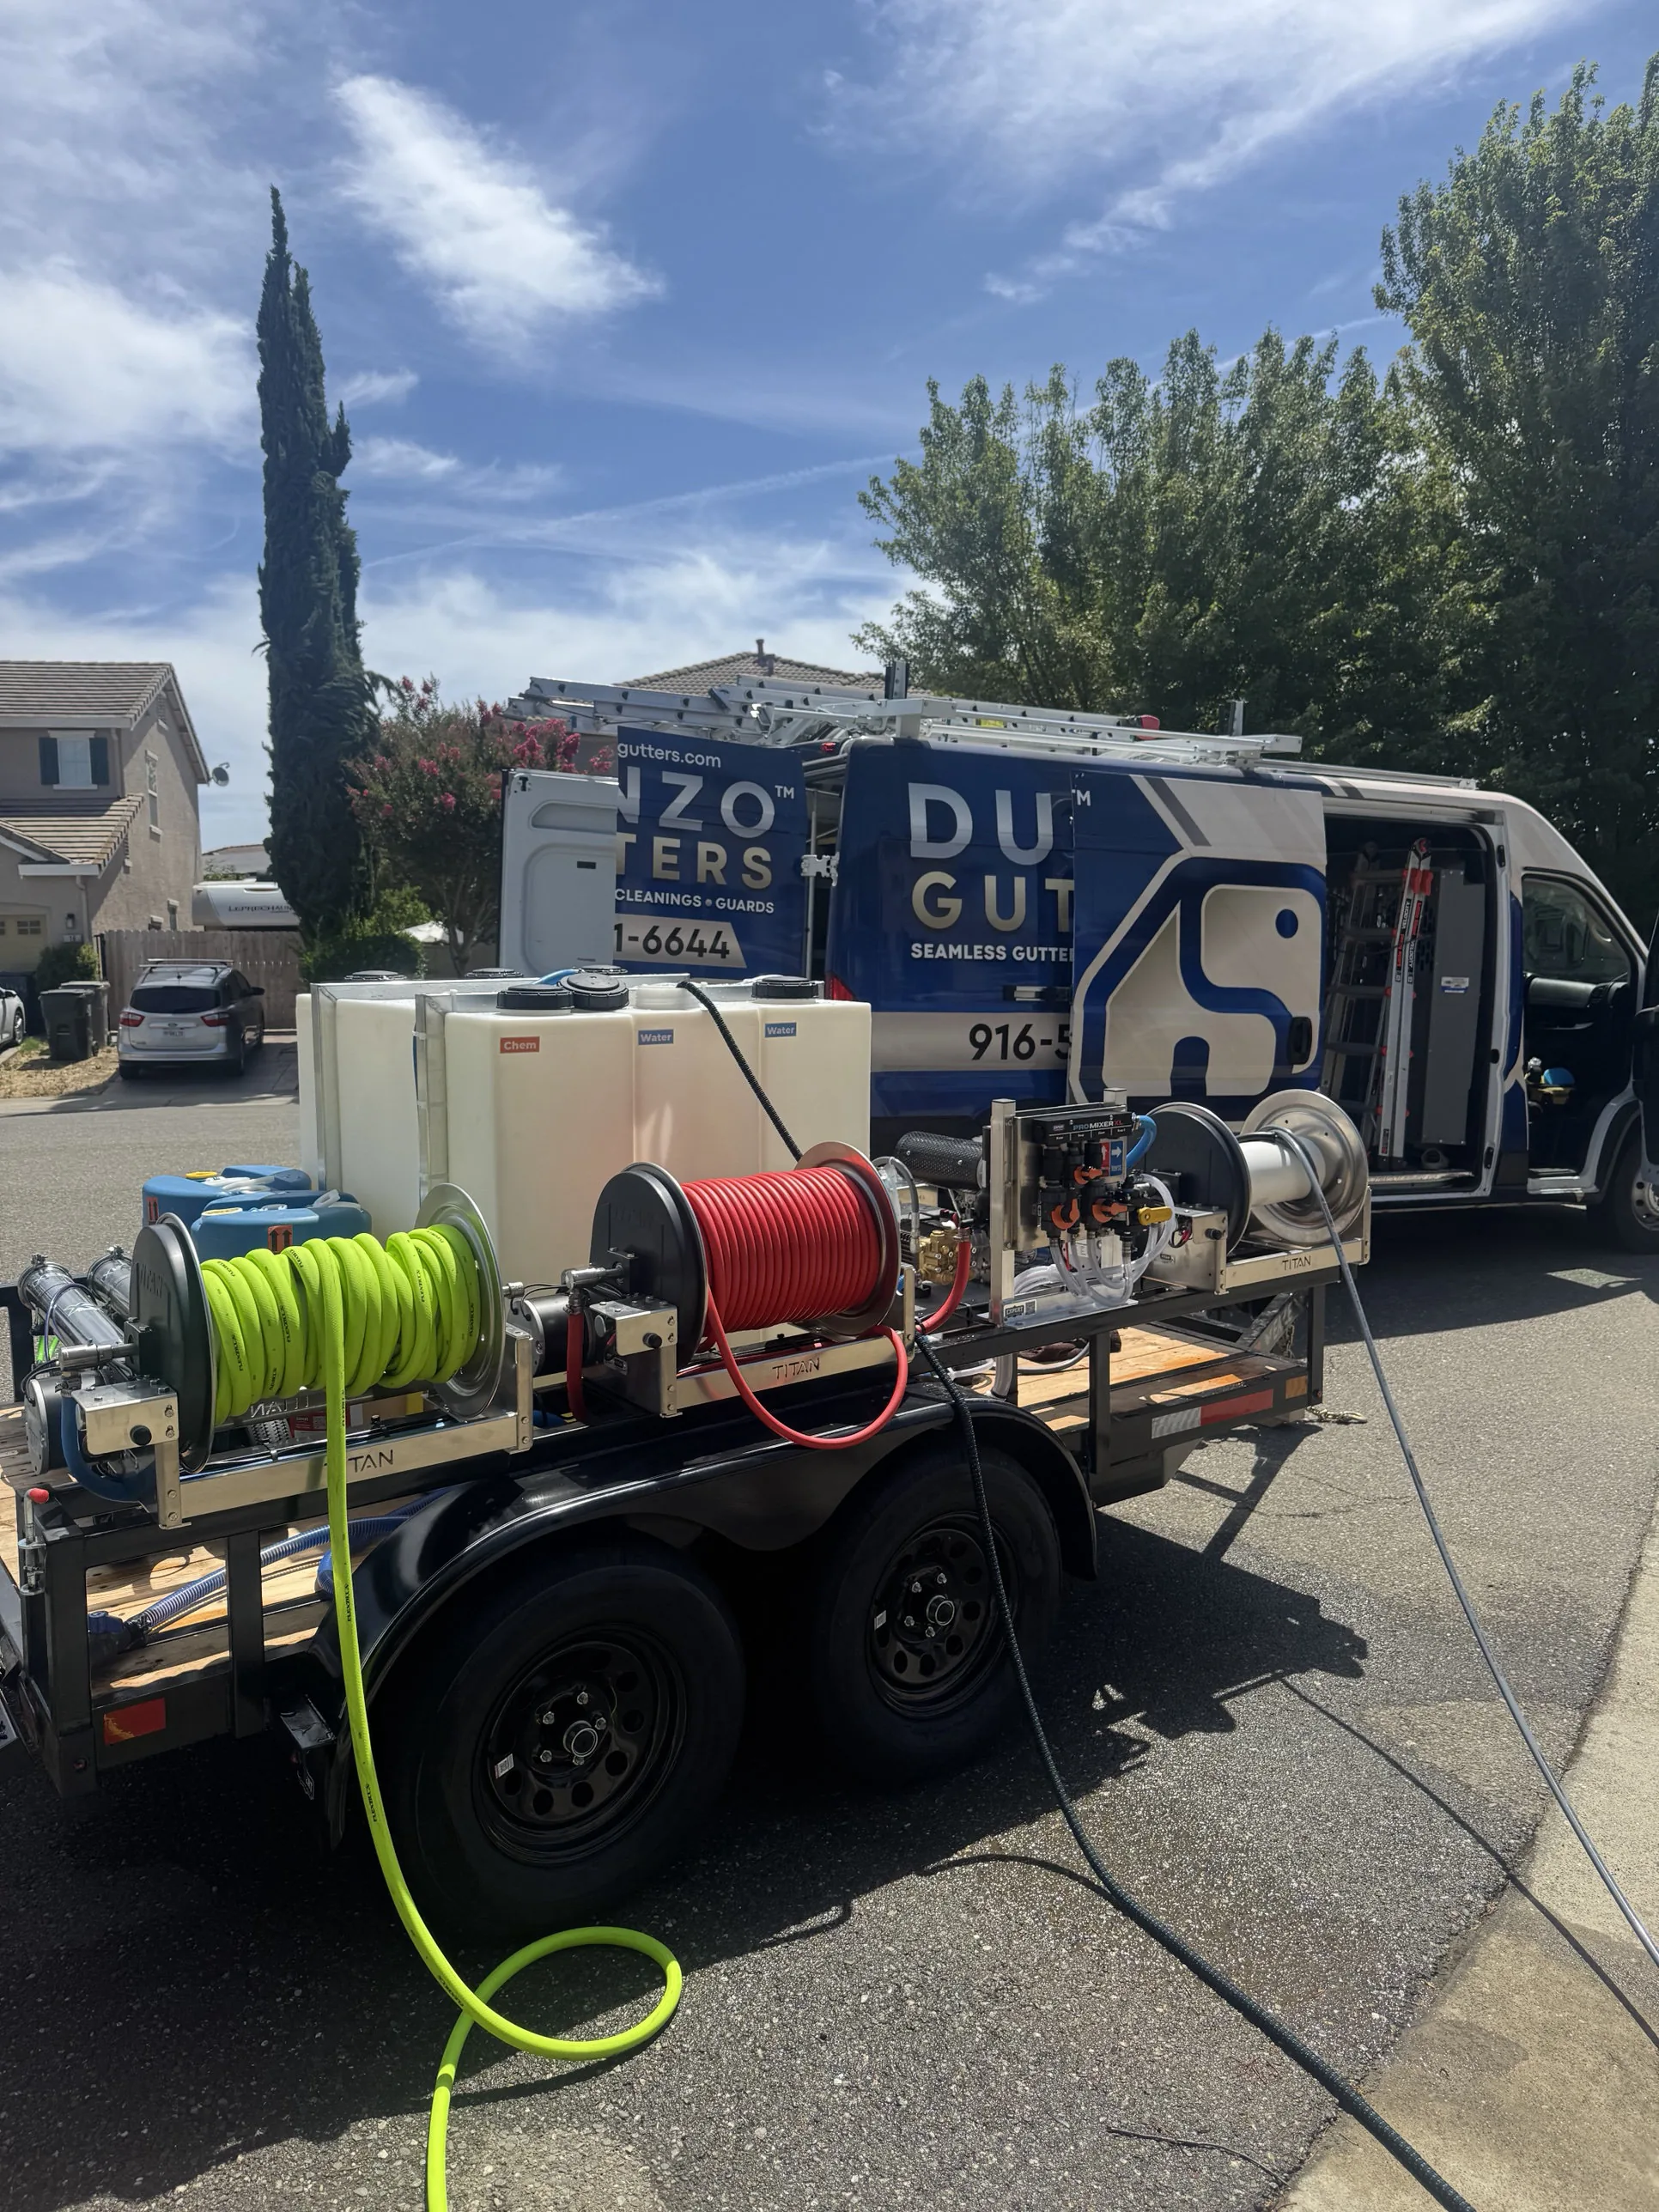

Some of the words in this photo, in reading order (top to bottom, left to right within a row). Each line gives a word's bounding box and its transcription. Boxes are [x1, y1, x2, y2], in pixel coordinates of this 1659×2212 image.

[617, 743, 721, 768] gutters.com
[775, 785, 794, 799] TM
[908, 782, 1053, 866] DU
[617, 832, 772, 890] TERS
[615, 889, 702, 908] CLEANINGS
[715, 897, 775, 914] GUARDS
[912, 872, 1074, 933] GUT
[614, 923, 730, 959] 1-6644
[911, 943, 1006, 960] SEAMLESS
[641, 1032, 672, 1042] Water
[767, 1024, 795, 1036] Water
[503, 1040, 537, 1051] Chem
[1282, 1255, 1311, 1271] TITAN
[772, 1358, 821, 1380] TITAN
[347, 1449, 393, 1473] TAN
[366, 1783, 378, 1822] FLEXZILLA
